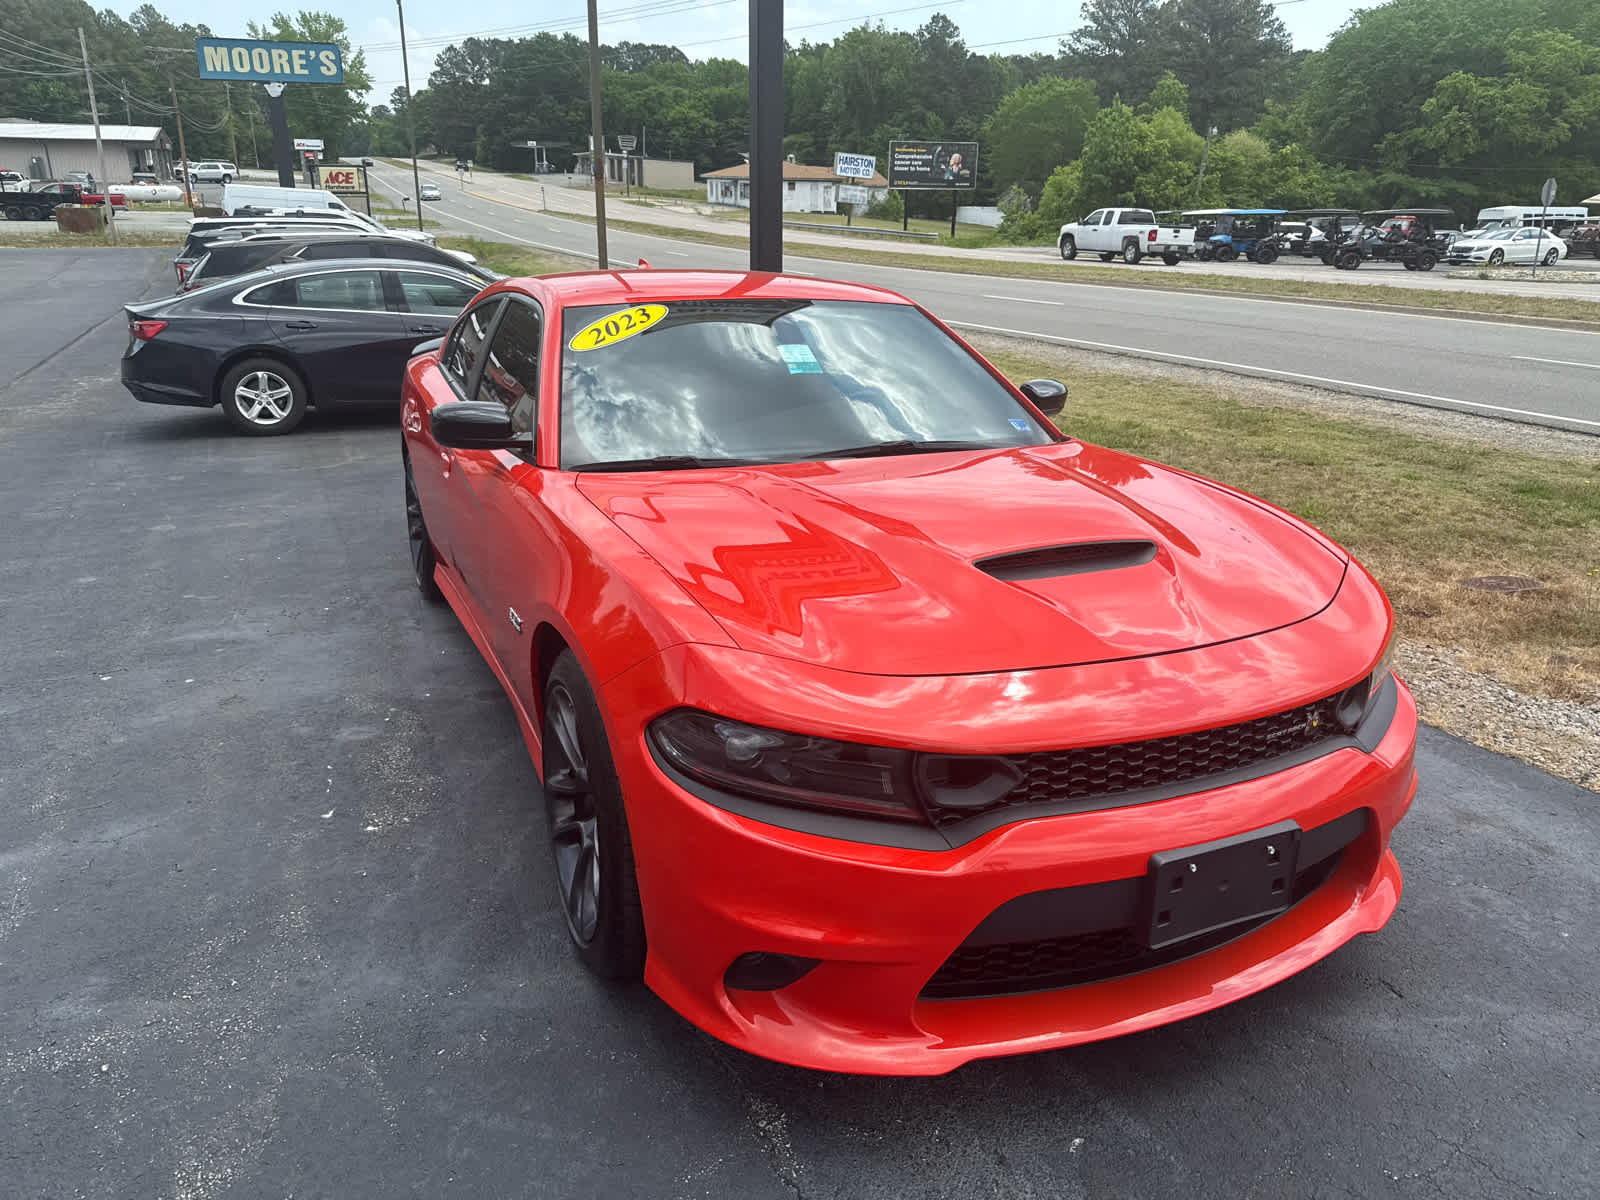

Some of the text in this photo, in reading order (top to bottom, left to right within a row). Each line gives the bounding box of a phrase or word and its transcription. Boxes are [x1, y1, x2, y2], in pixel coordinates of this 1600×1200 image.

[203, 46, 338, 76] MOORE'S
[839, 155, 875, 169] HAIRSTON
[325, 170, 355, 185] ACE
[840, 166, 861, 176] MOTOR
[588, 307, 651, 346] 2023
